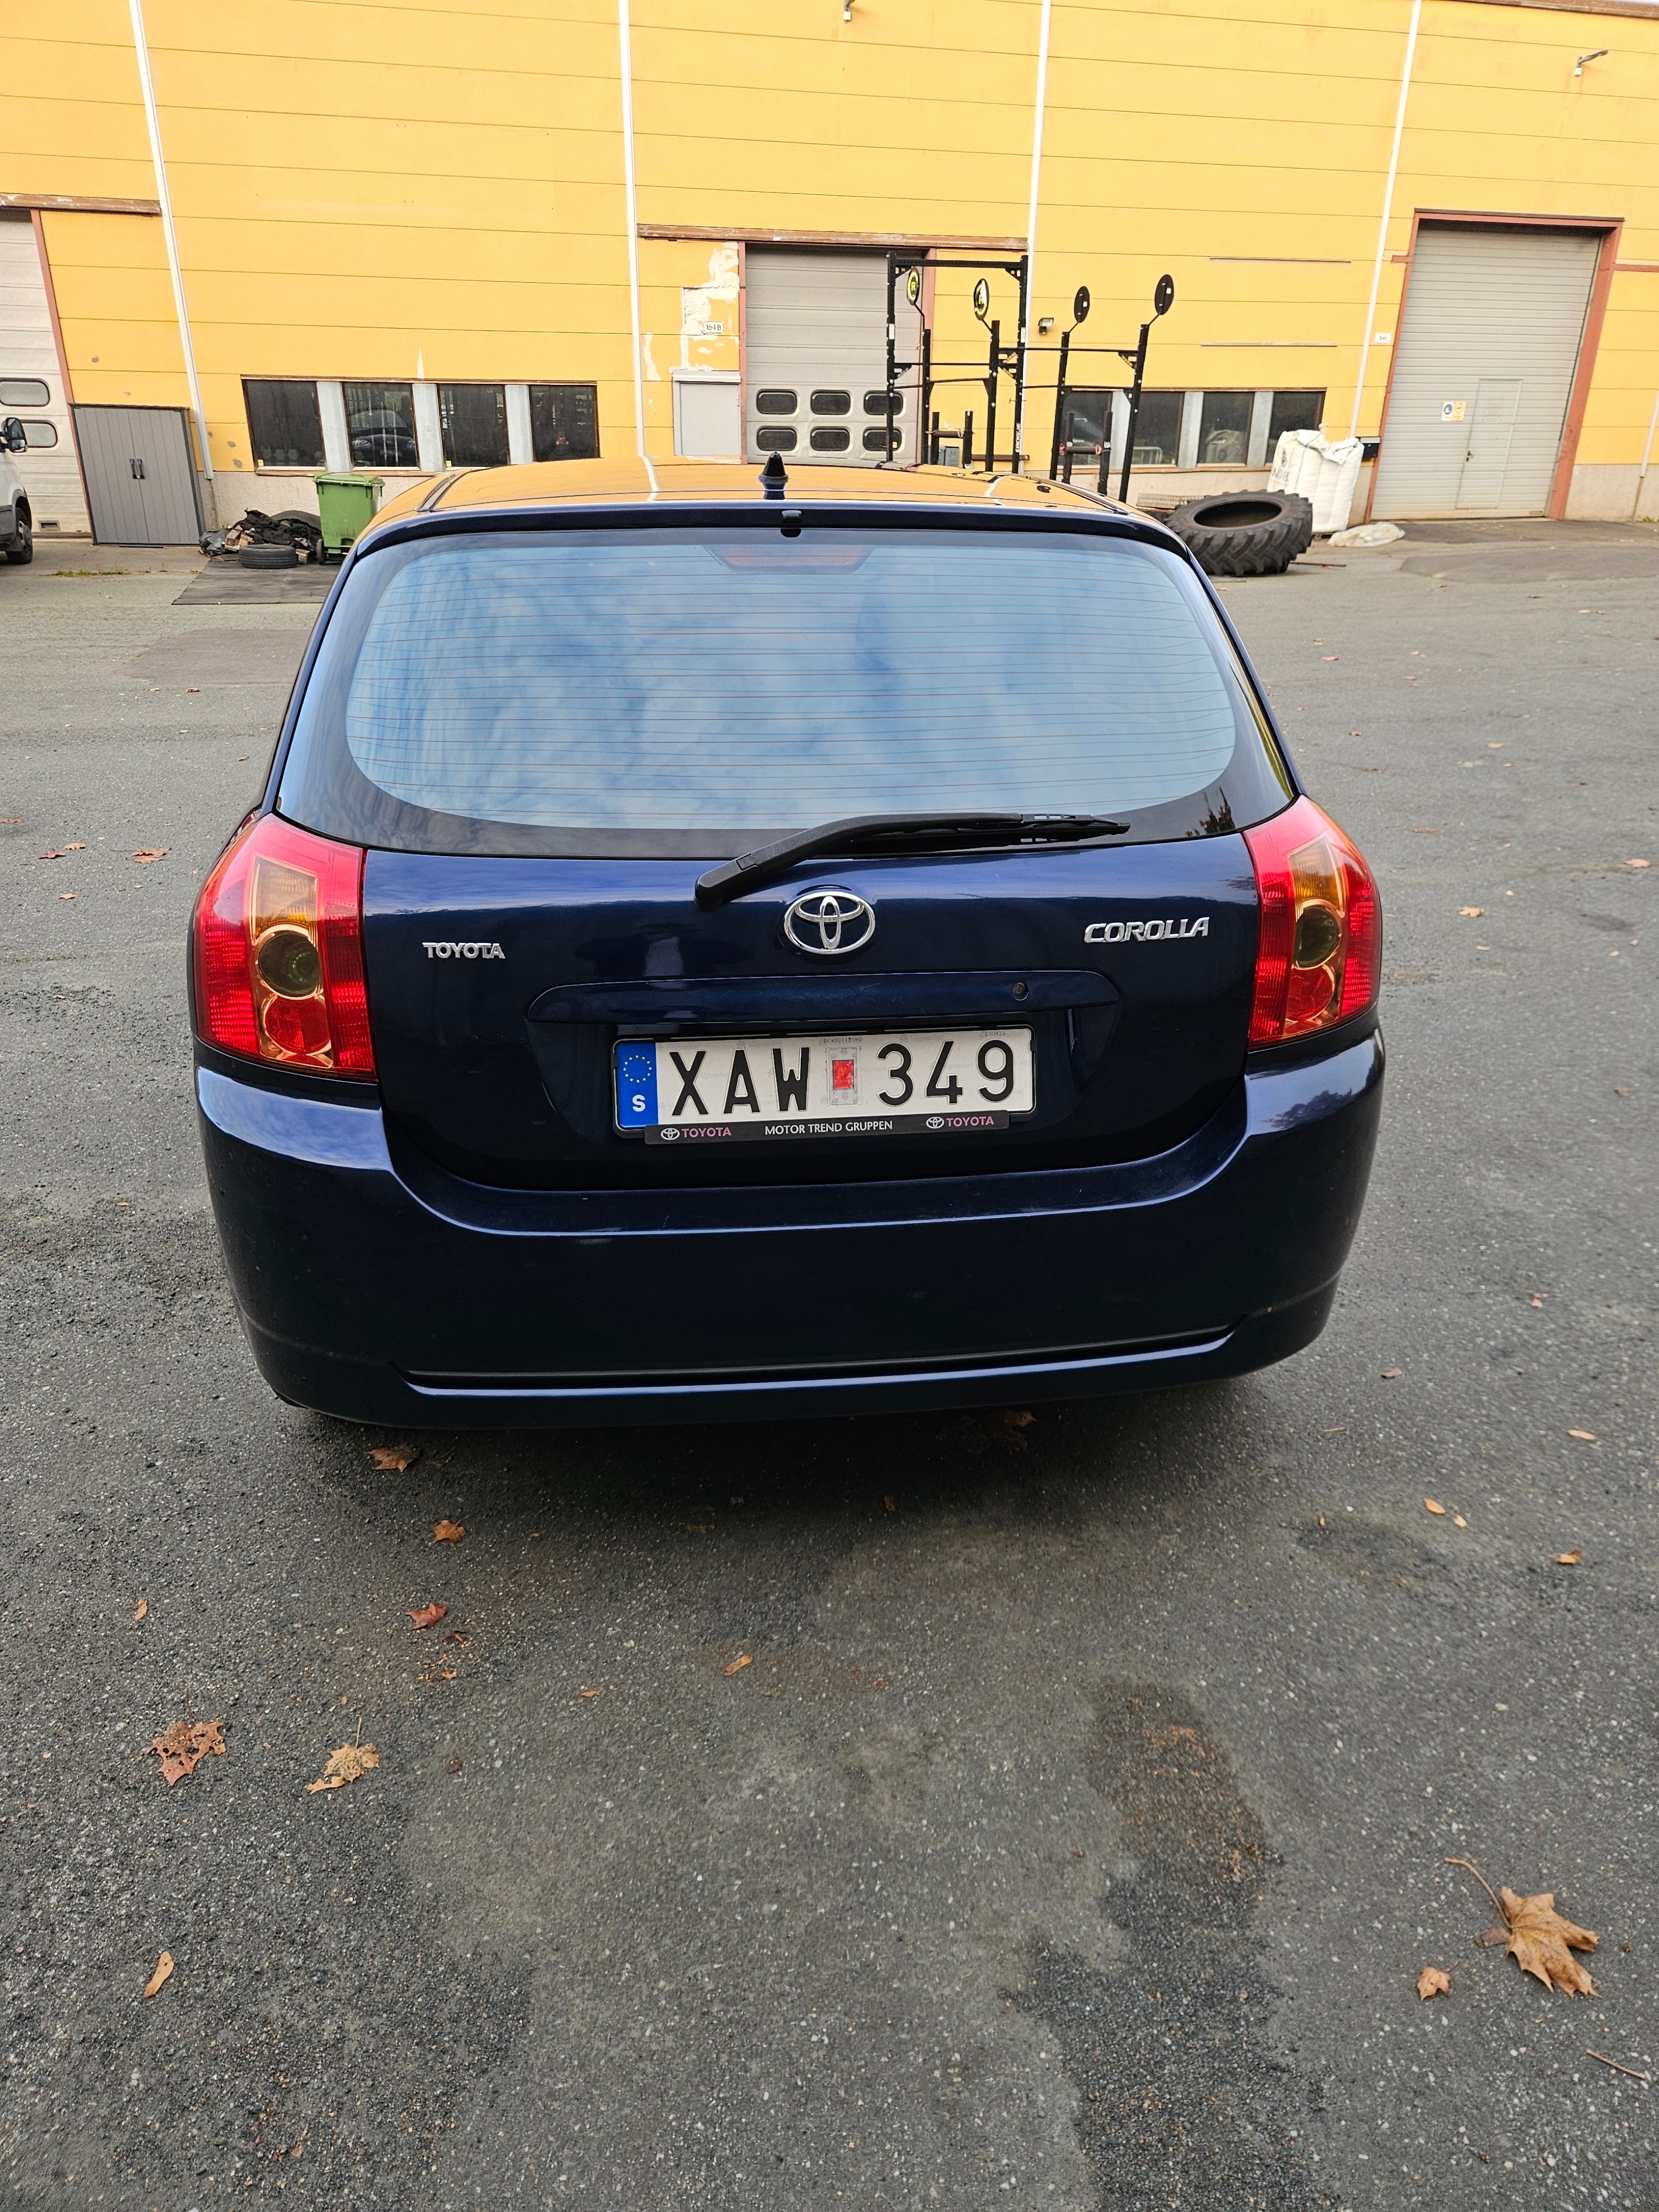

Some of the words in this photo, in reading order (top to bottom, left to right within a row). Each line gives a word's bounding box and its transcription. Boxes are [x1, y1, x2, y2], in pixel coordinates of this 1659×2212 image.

[1084, 917, 1209, 943] COROLLA
[422, 942, 505, 959] TOYOTA
[669, 1047, 810, 1116] XAW
[877, 1039, 1014, 1105] 349
[632, 1094, 646, 1112] S
[765, 1124, 806, 1135] MOTOR
[808, 1123, 842, 1133] TREND
[846, 1120, 893, 1131] GRUPPEN
[946, 1116, 994, 1127] TOYOTA
[681, 1127, 732, 1138] TOYOTA
